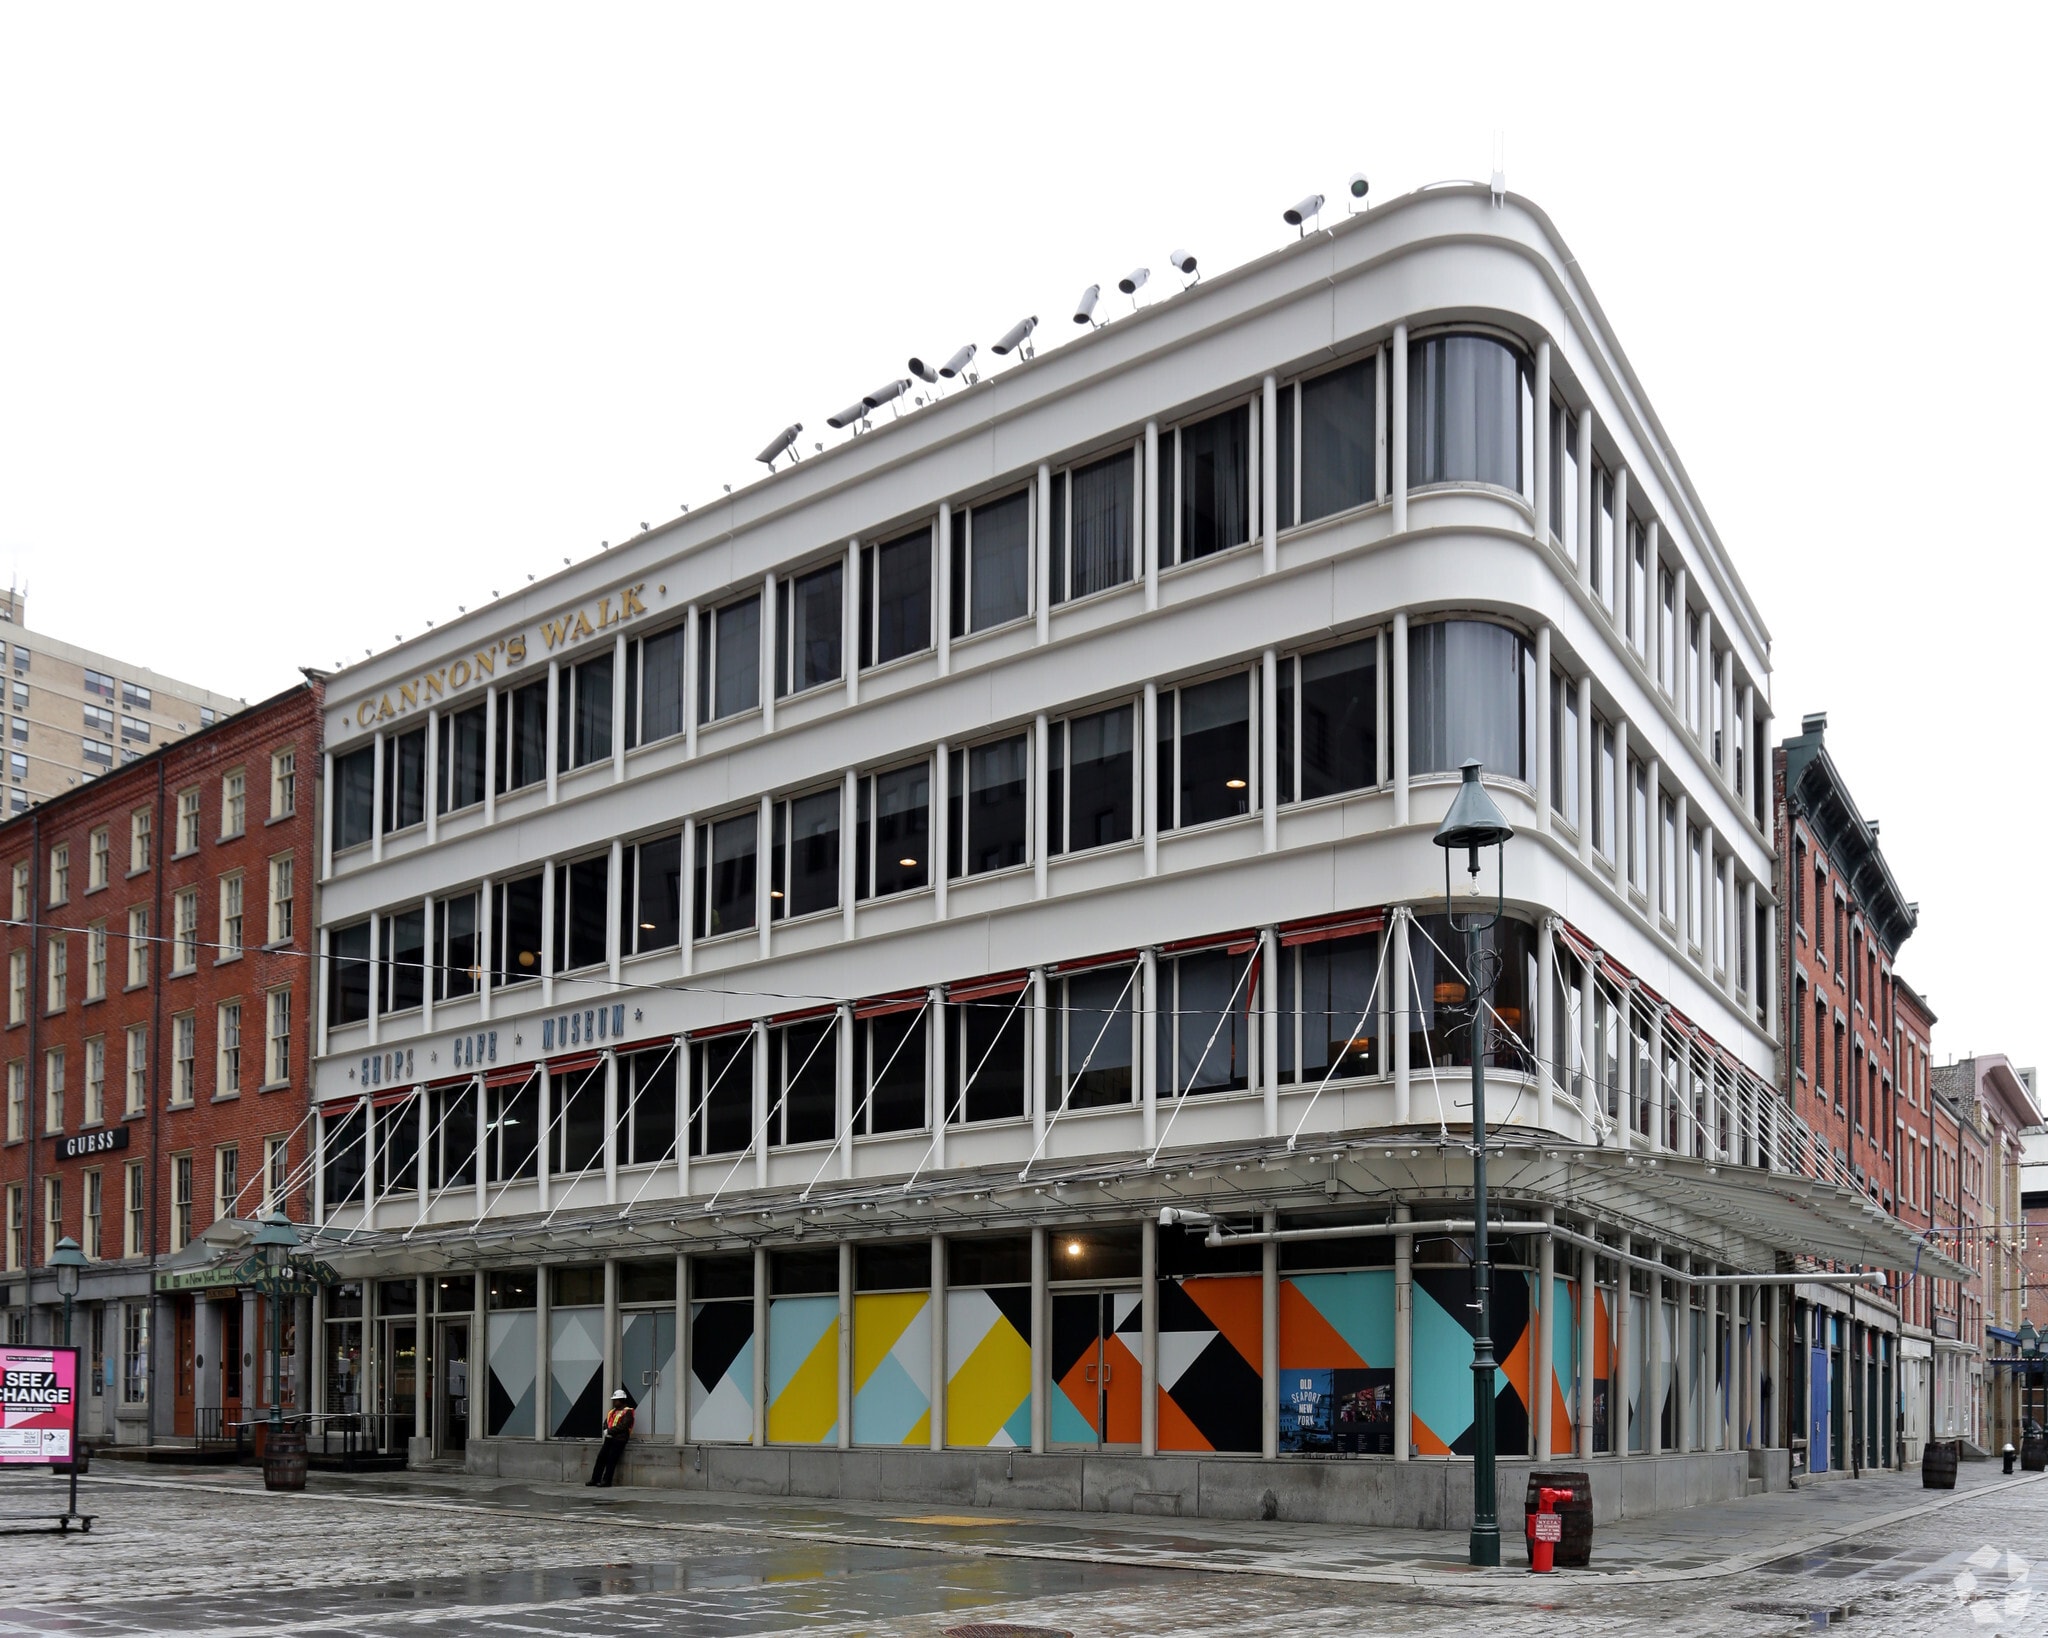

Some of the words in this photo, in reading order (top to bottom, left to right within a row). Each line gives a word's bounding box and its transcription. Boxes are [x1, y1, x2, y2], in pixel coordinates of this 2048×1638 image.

[356, 633, 527, 728] CANNON'S
[540, 583, 649, 650] WALK
[360, 1048, 414, 1086] SHOPS
[453, 1031, 498, 1067] CAFE
[541, 1003, 625, 1050] MUSEUM
[66, 1130, 114, 1156] GUESS
[1299, 1379, 1312, 1390] OLD
[0, 1387, 70, 1404] HANGE
[1290, 1391, 1322, 1404] SEAPORT
[1298, 1403, 1313, 1414] NEW
[1297, 1415, 1315, 1426] YORK
